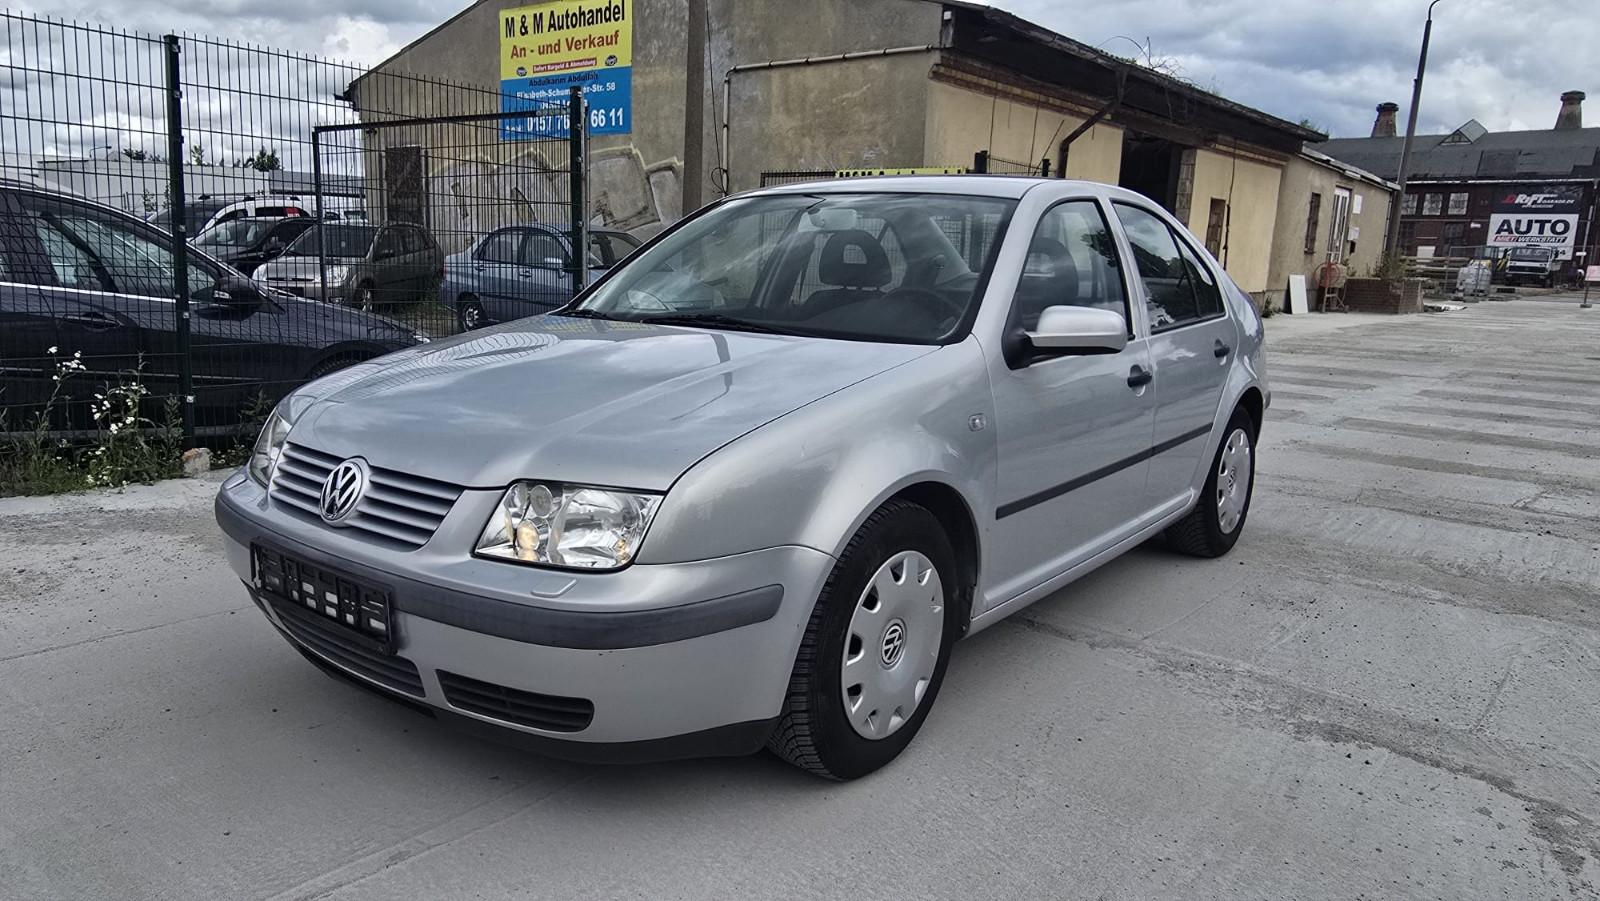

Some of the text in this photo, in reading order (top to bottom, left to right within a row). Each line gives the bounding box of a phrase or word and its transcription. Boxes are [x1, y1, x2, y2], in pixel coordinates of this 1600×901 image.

[505, 0, 625, 38] M & M Autohandel
[511, 45, 527, 59] An
[538, 39, 560, 56] und
[566, 30, 619, 52] Verkauf
[606, 82, 616, 92] 58
[590, 109, 606, 127] 66
[609, 107, 623, 126] 11
[1495, 219, 1570, 235] AUTO
